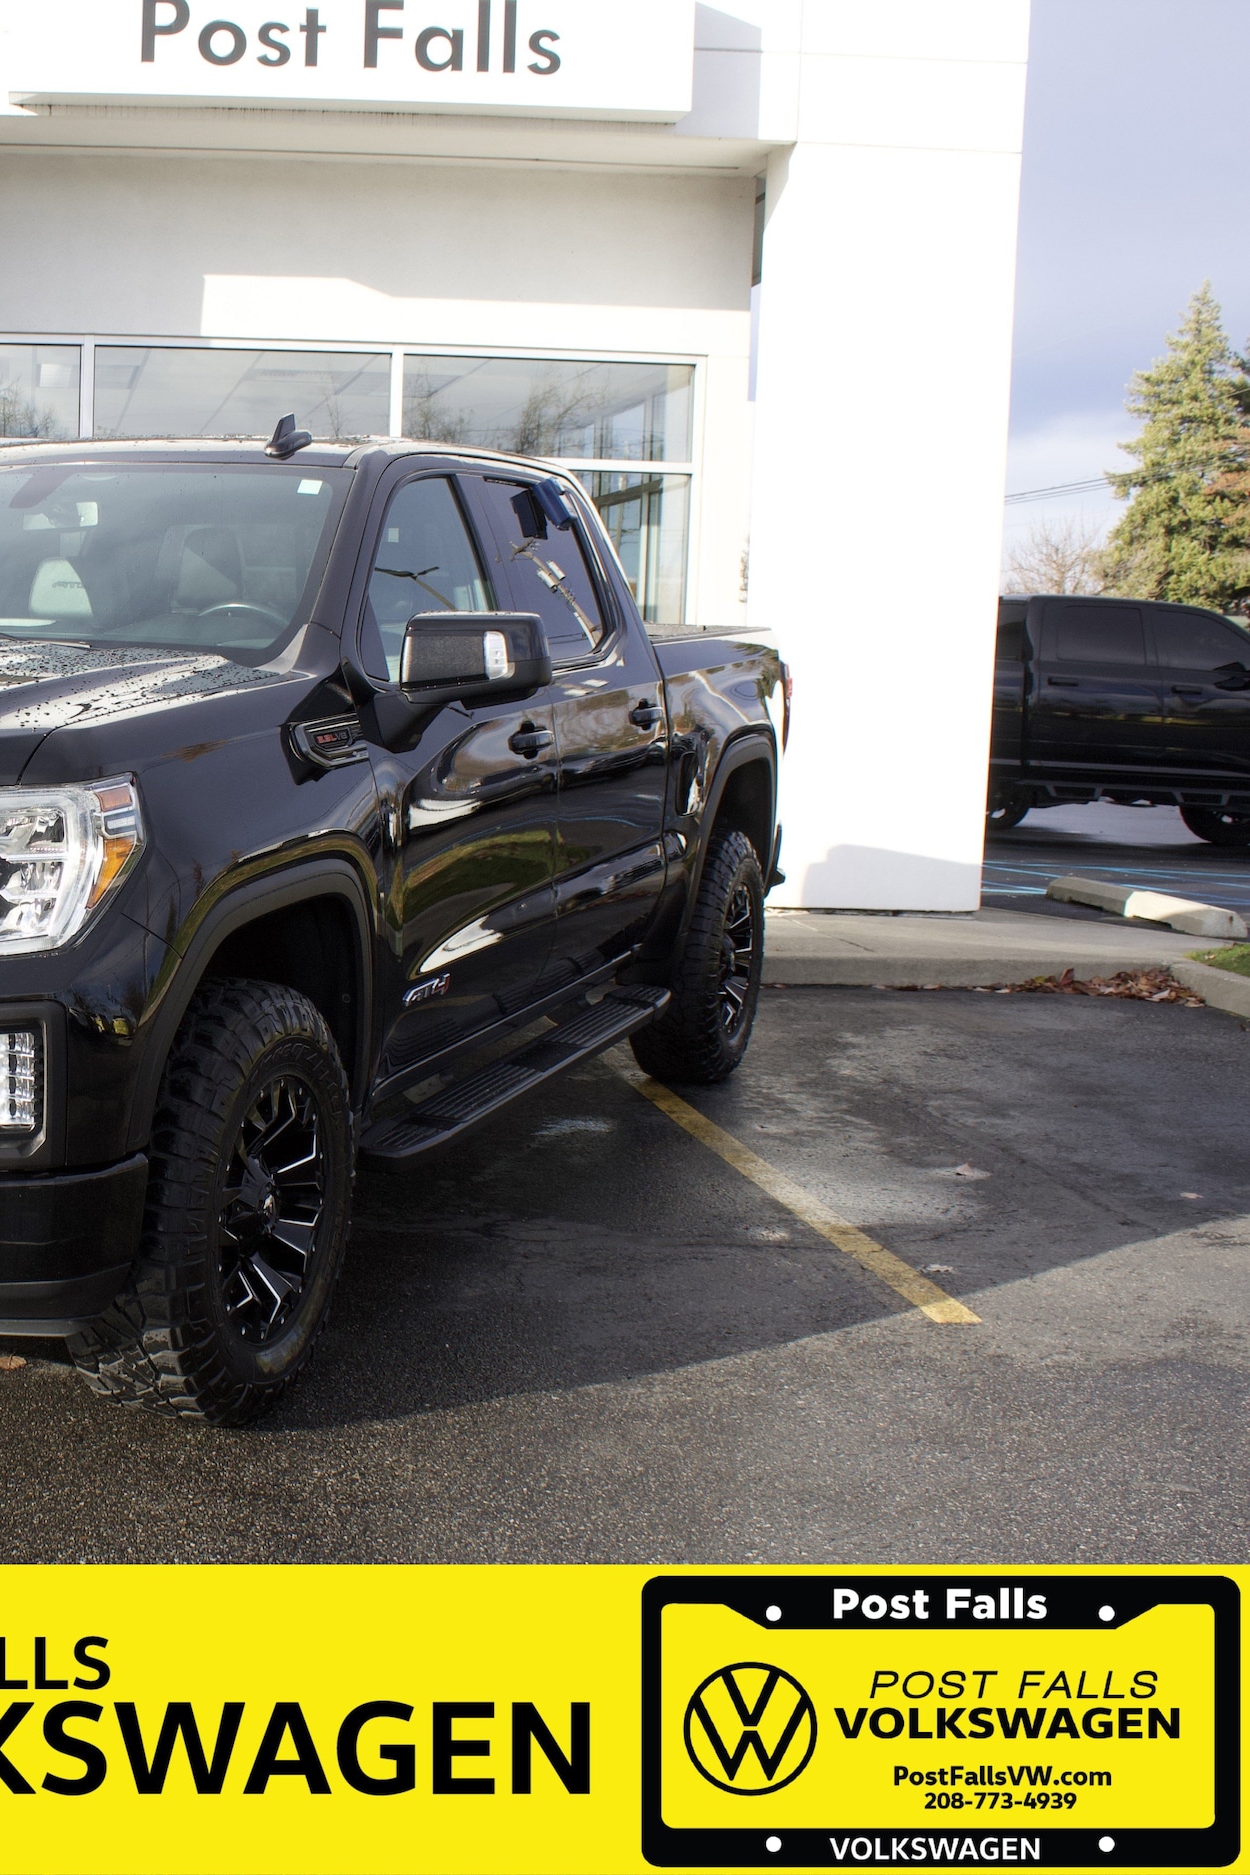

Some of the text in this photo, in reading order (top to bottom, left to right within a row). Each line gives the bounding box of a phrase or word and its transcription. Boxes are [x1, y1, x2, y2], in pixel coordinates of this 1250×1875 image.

[141, 0, 561, 75] Post Falls
[402, 972, 451, 1007] AT4
